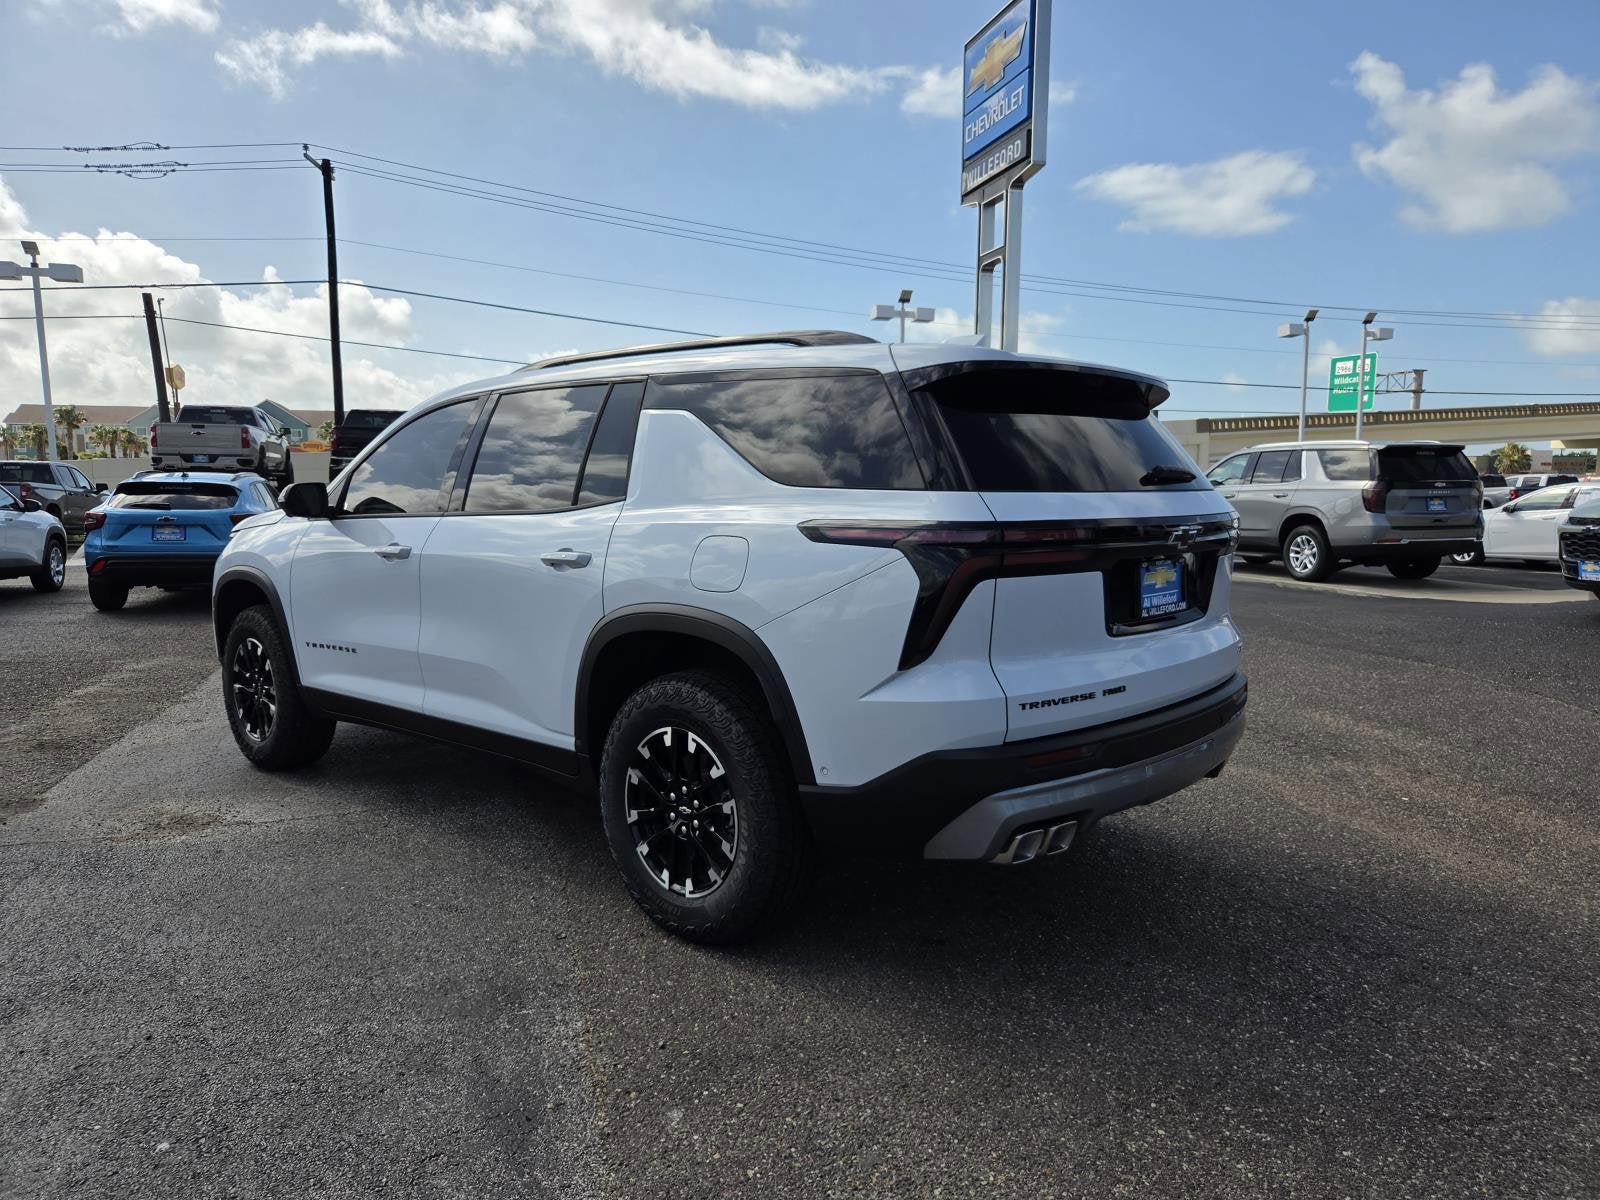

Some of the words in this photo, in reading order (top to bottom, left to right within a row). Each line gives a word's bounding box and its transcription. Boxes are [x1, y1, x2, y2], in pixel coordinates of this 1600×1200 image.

[965, 85, 1024, 144] CHEVROLET
[967, 140, 1021, 188] WILLEFORD
[305, 641, 358, 653] TRAVERSE
[1018, 691, 1097, 711] TRAVERSE
